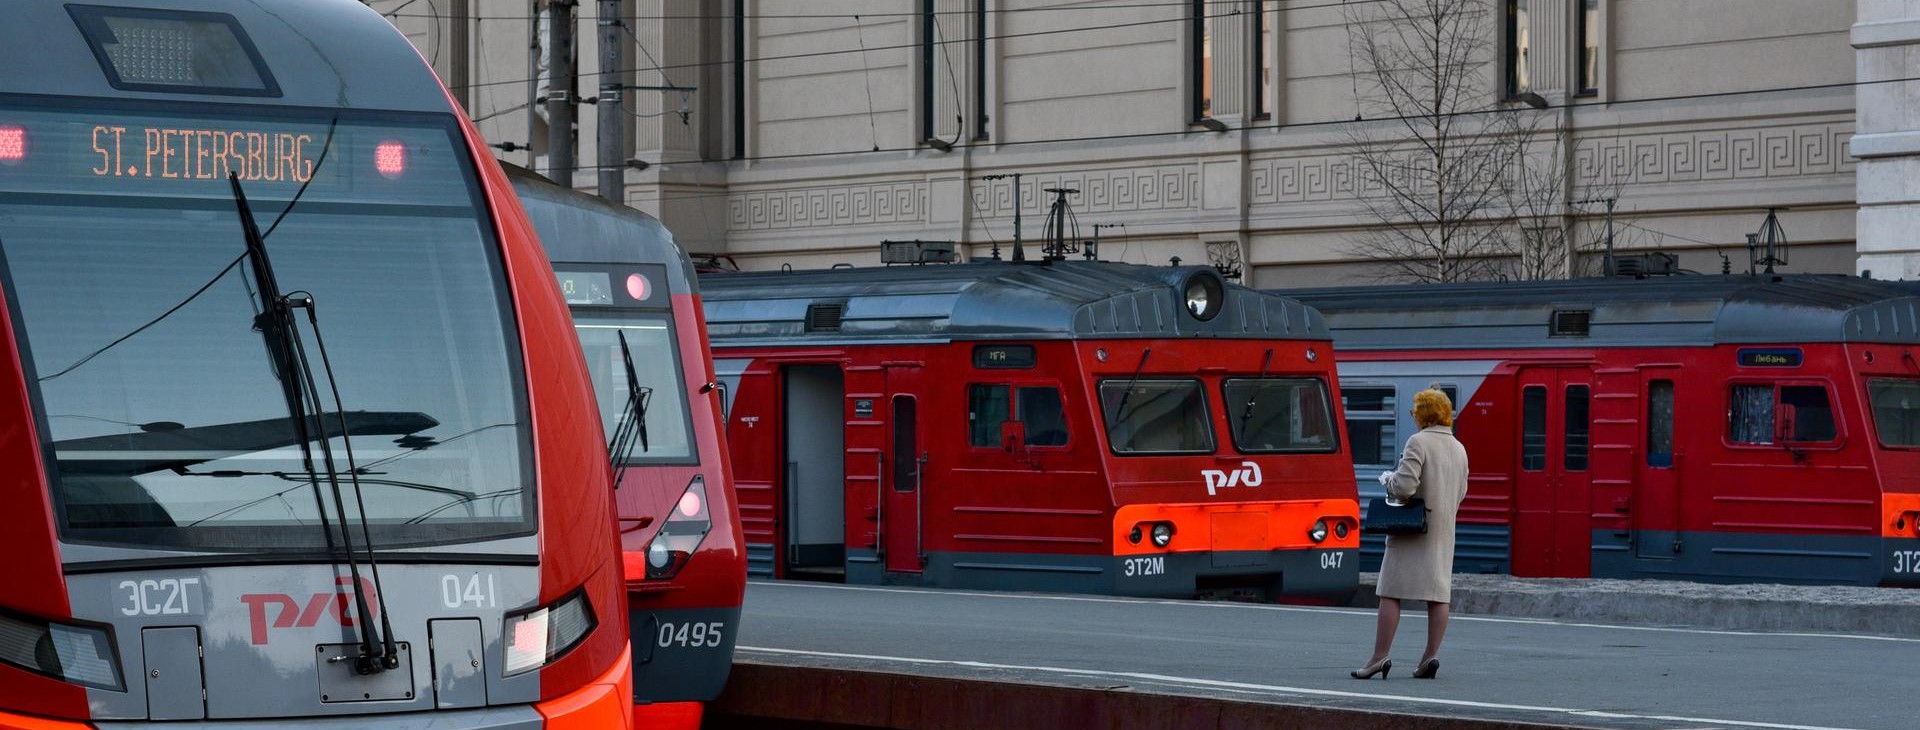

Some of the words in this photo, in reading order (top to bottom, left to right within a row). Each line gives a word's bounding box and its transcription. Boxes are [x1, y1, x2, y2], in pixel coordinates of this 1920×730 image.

[1124, 556, 1164, 577] ЭТ2М
[1320, 551, 1344, 569] 047
[119, 577, 199, 616] ЭС2Г
[441, 573, 496, 608] 041
[658, 622, 724, 647] 0495
